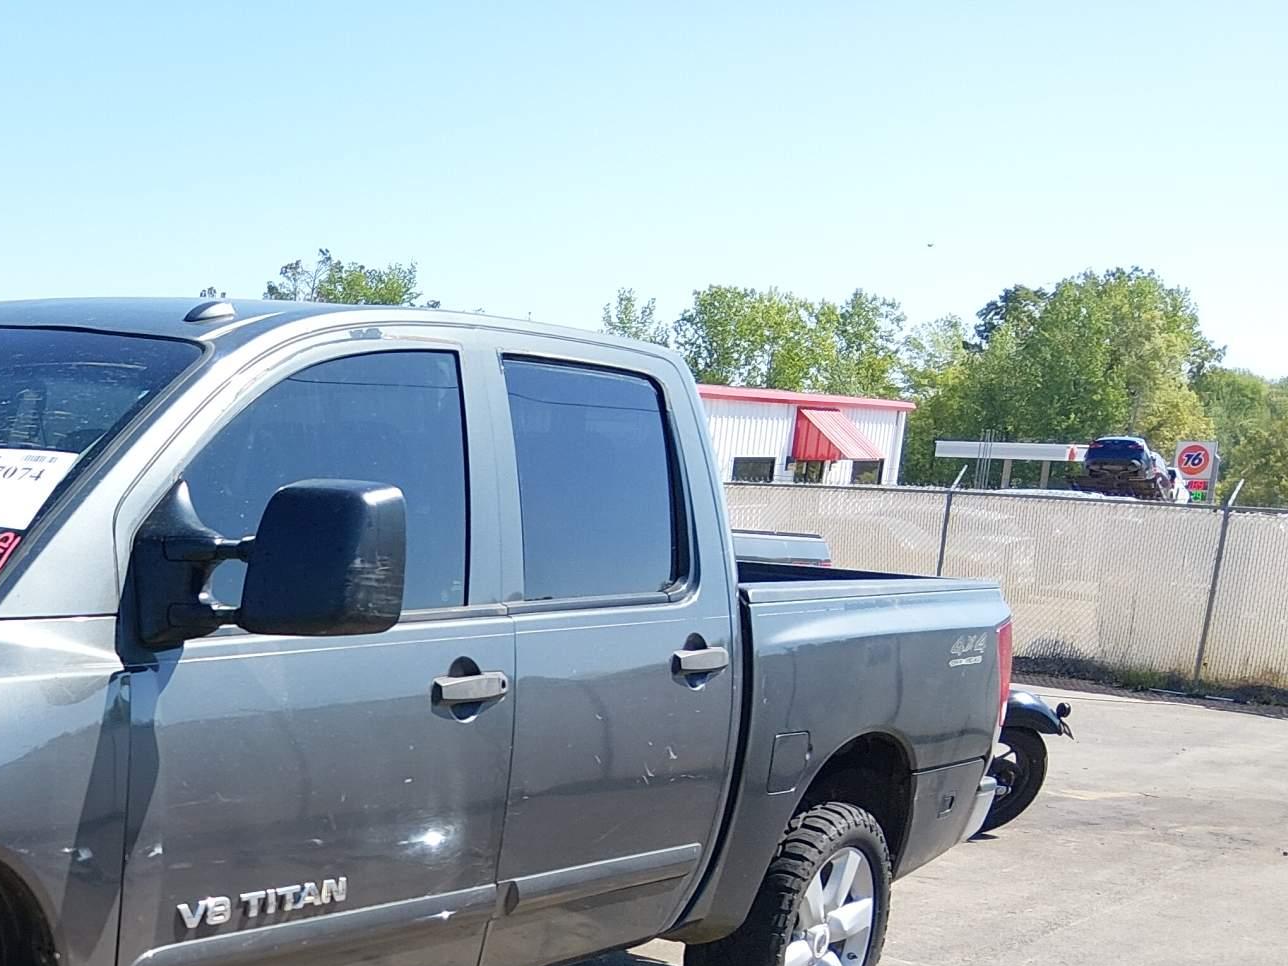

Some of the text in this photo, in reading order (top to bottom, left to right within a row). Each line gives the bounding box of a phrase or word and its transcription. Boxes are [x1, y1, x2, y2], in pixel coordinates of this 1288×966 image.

[1183, 451, 1204, 467] 76
[177, 876, 347, 929] V8 TITAN
